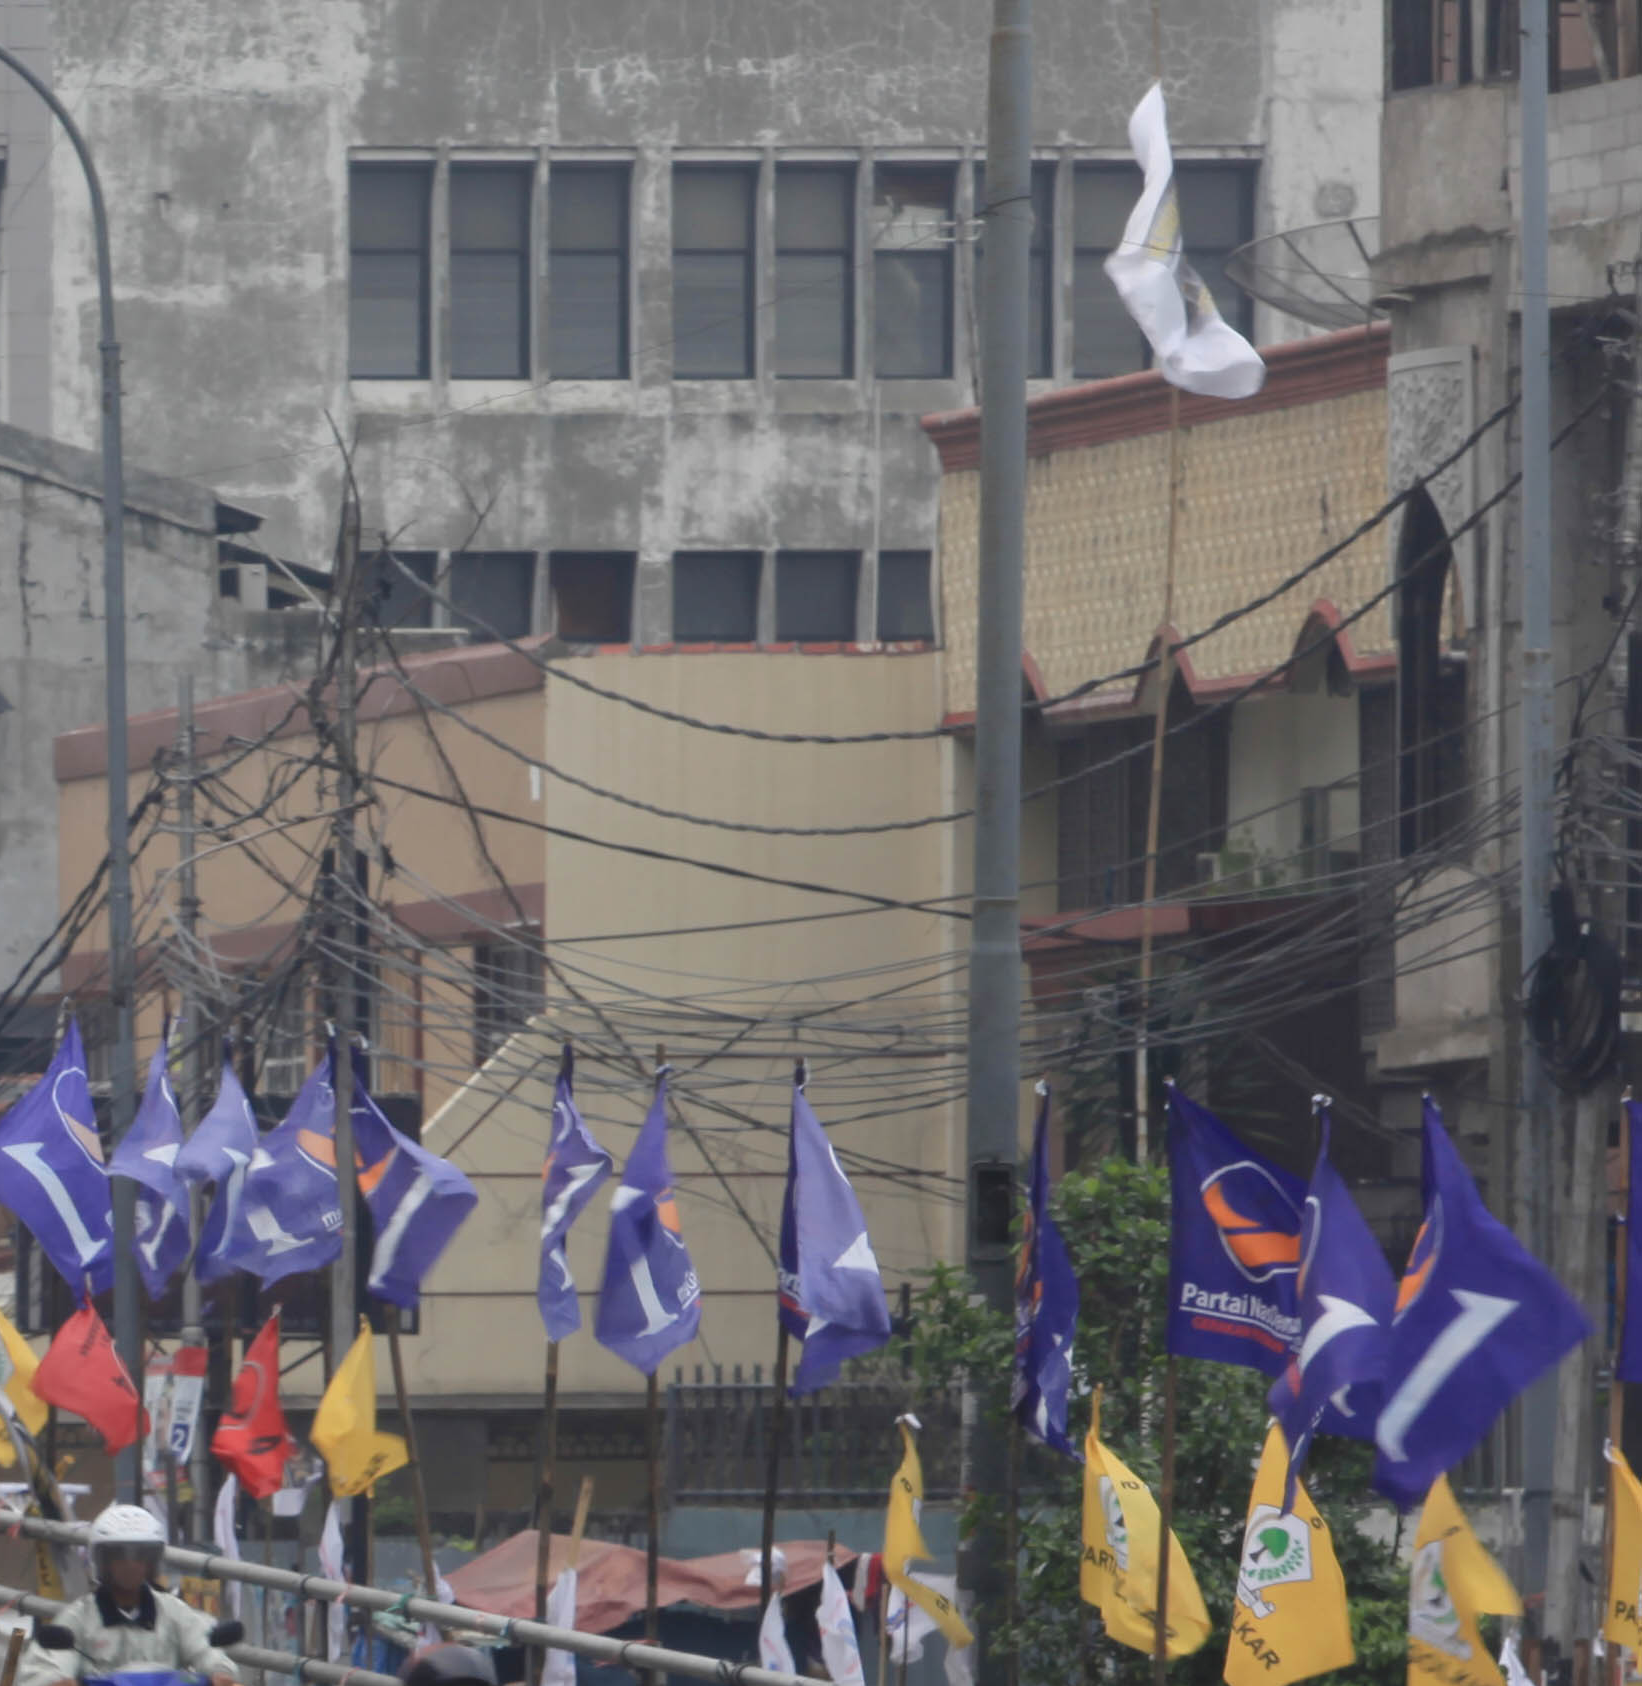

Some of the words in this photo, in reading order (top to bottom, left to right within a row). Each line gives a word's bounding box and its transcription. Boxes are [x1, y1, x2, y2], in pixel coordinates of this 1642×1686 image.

[0, 1142, 108, 1268] 1
[369, 1168, 433, 1289] 1
[1180, 1282, 1249, 1315] Partai
[1376, 1288, 1518, 1463] 1
